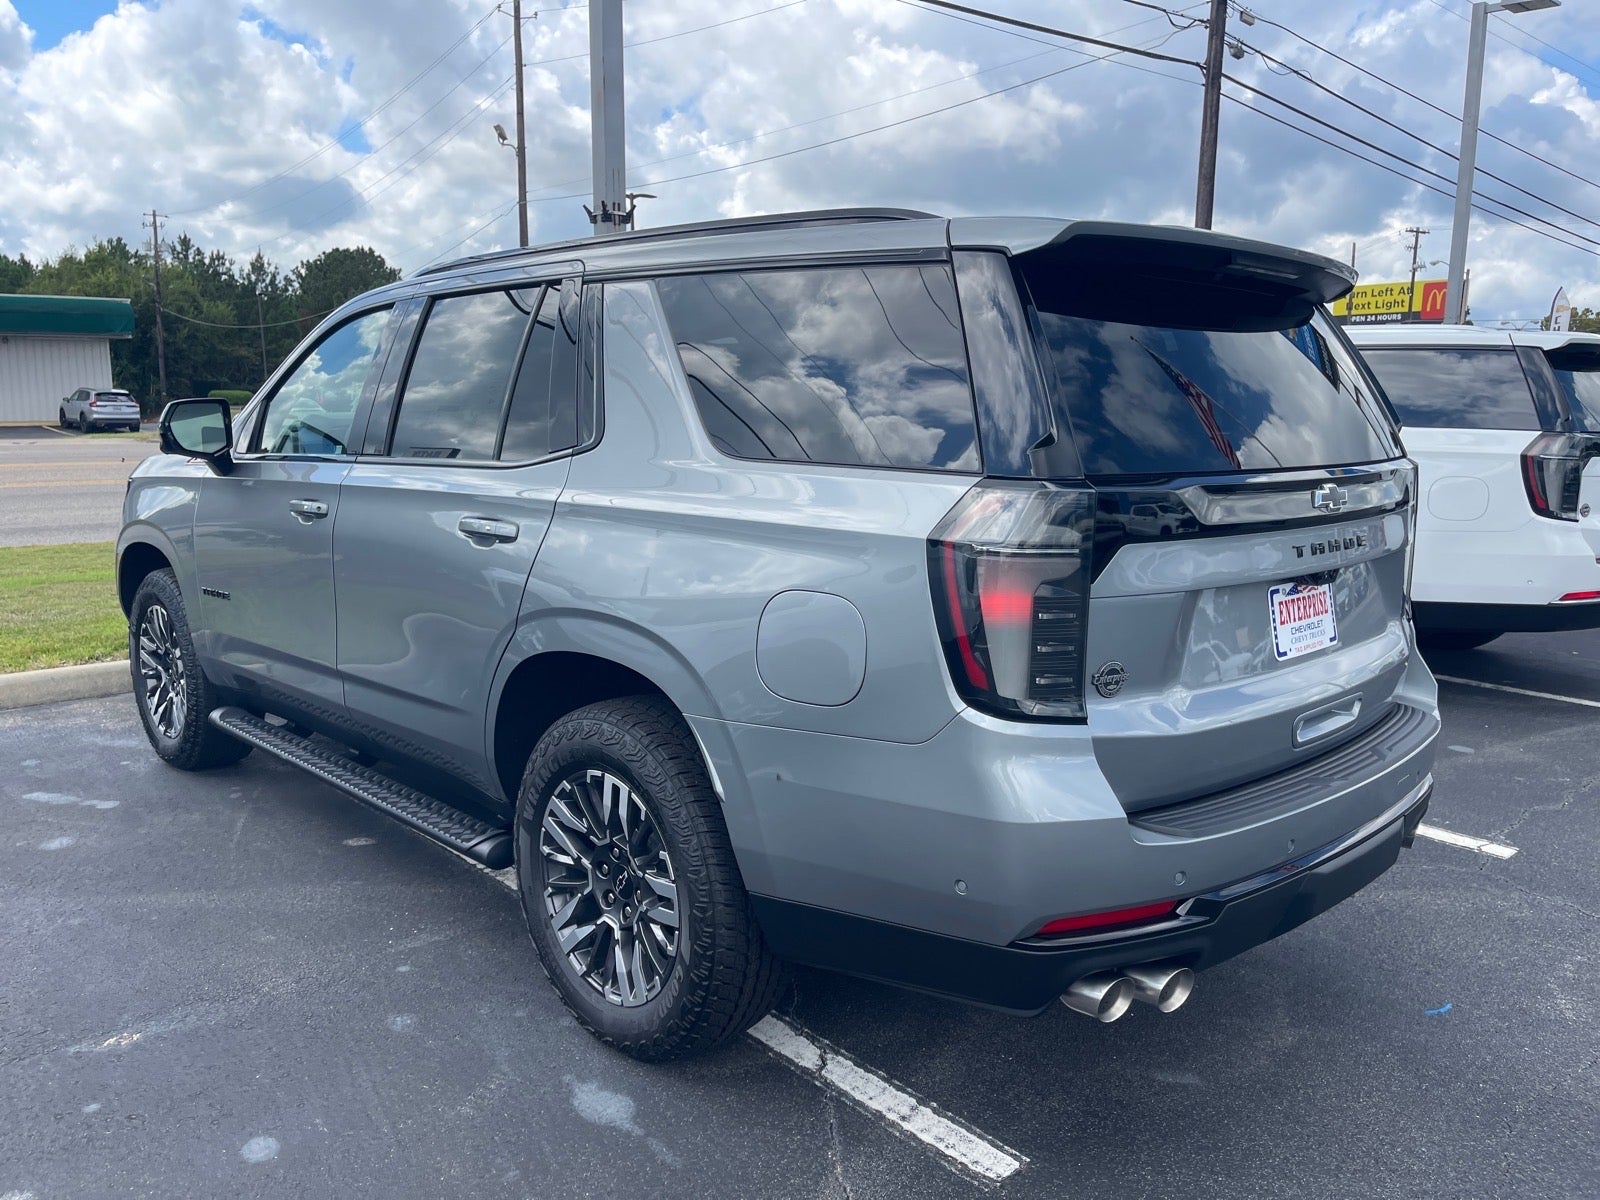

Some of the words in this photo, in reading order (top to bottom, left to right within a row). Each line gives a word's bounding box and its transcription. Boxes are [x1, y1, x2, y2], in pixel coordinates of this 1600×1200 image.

[1371, 287, 1394, 298] Left
[1398, 286, 1412, 296] At
[1375, 299, 1405, 310] Light
[1292, 535, 1367, 559] TAHOE
[1278, 591, 1328, 626] ENTERPRISE
[1291, 619, 1323, 635] CHEVROLET
[1291, 634, 1309, 645] CHEVY
[1309, 629, 1326, 640] TRUCKS
